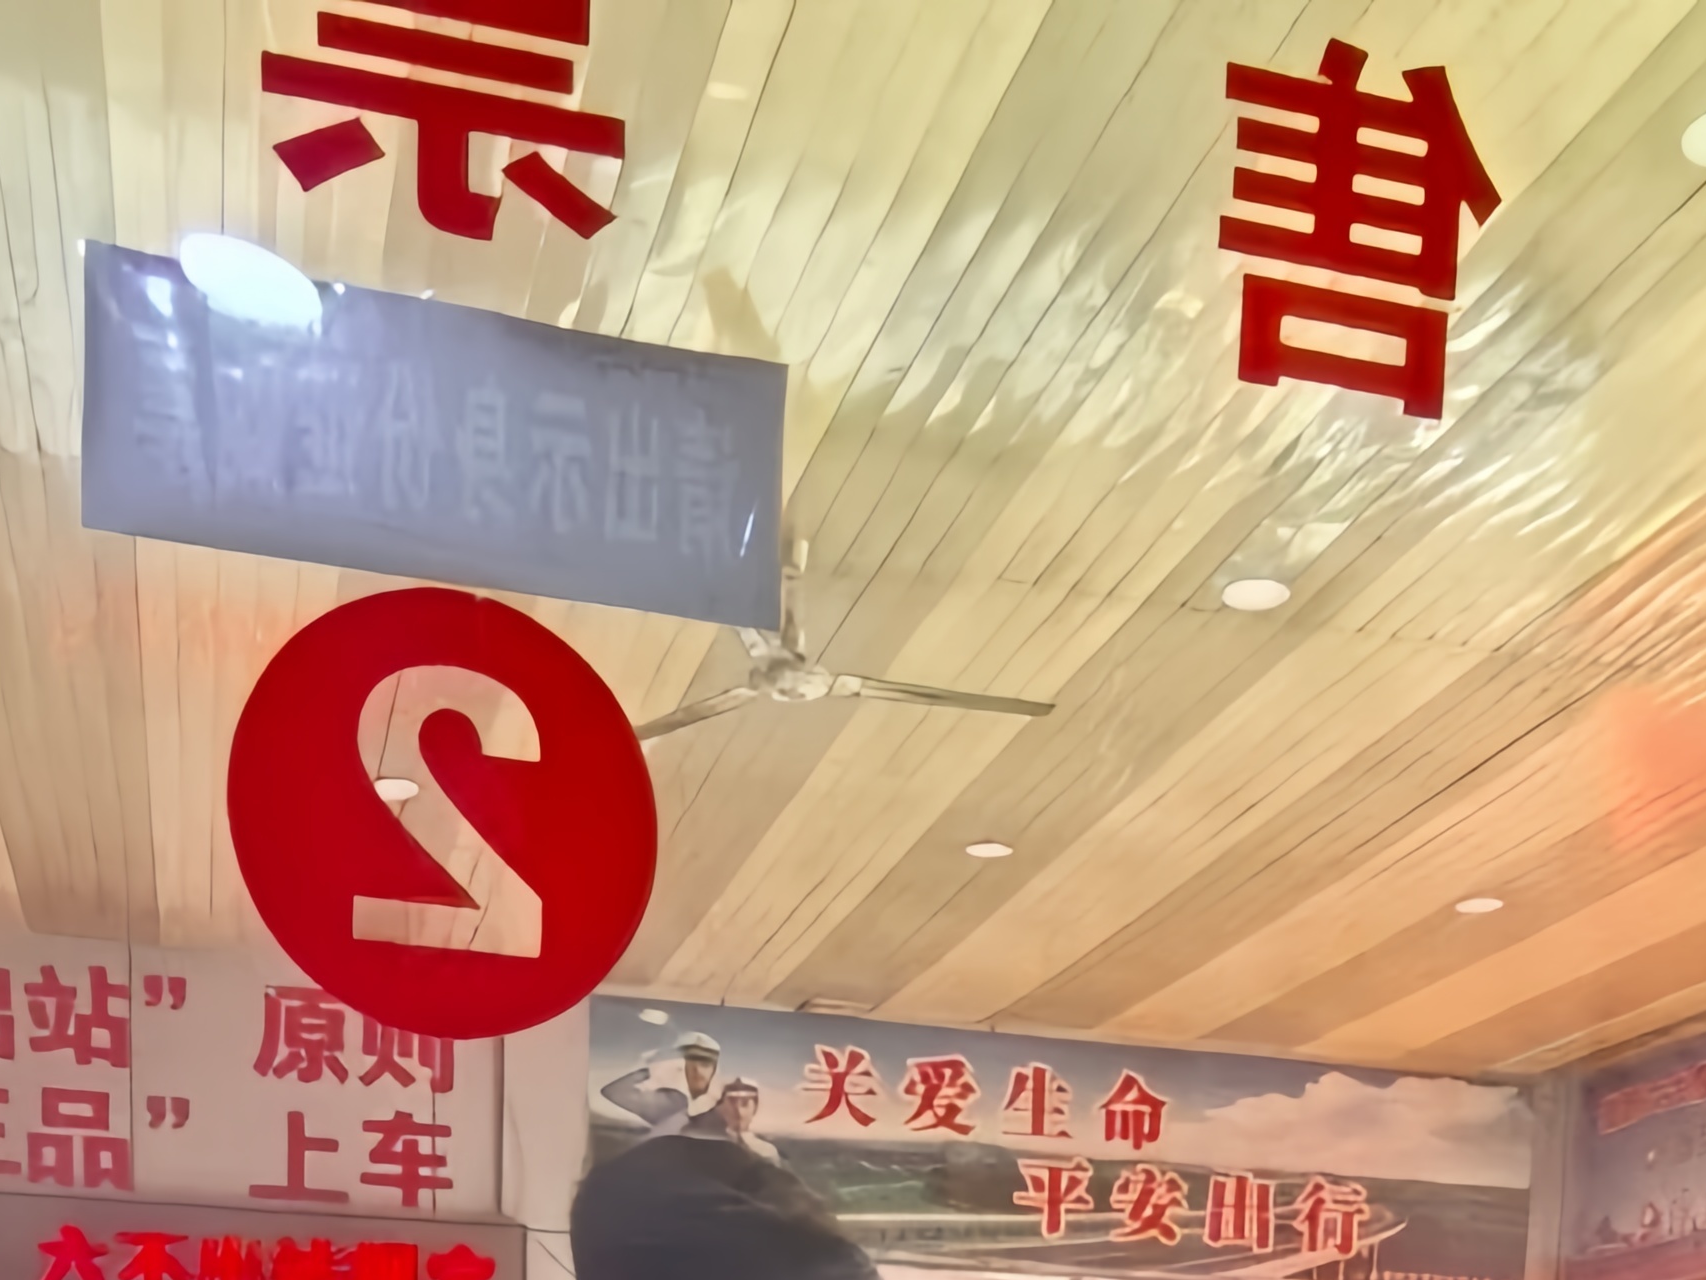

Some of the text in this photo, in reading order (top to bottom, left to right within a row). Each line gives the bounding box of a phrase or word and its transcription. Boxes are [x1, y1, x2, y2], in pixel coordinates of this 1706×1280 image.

[801, 1043, 1169, 1152] 关爱生命
[1013, 1155, 1371, 1258] 平安出行
